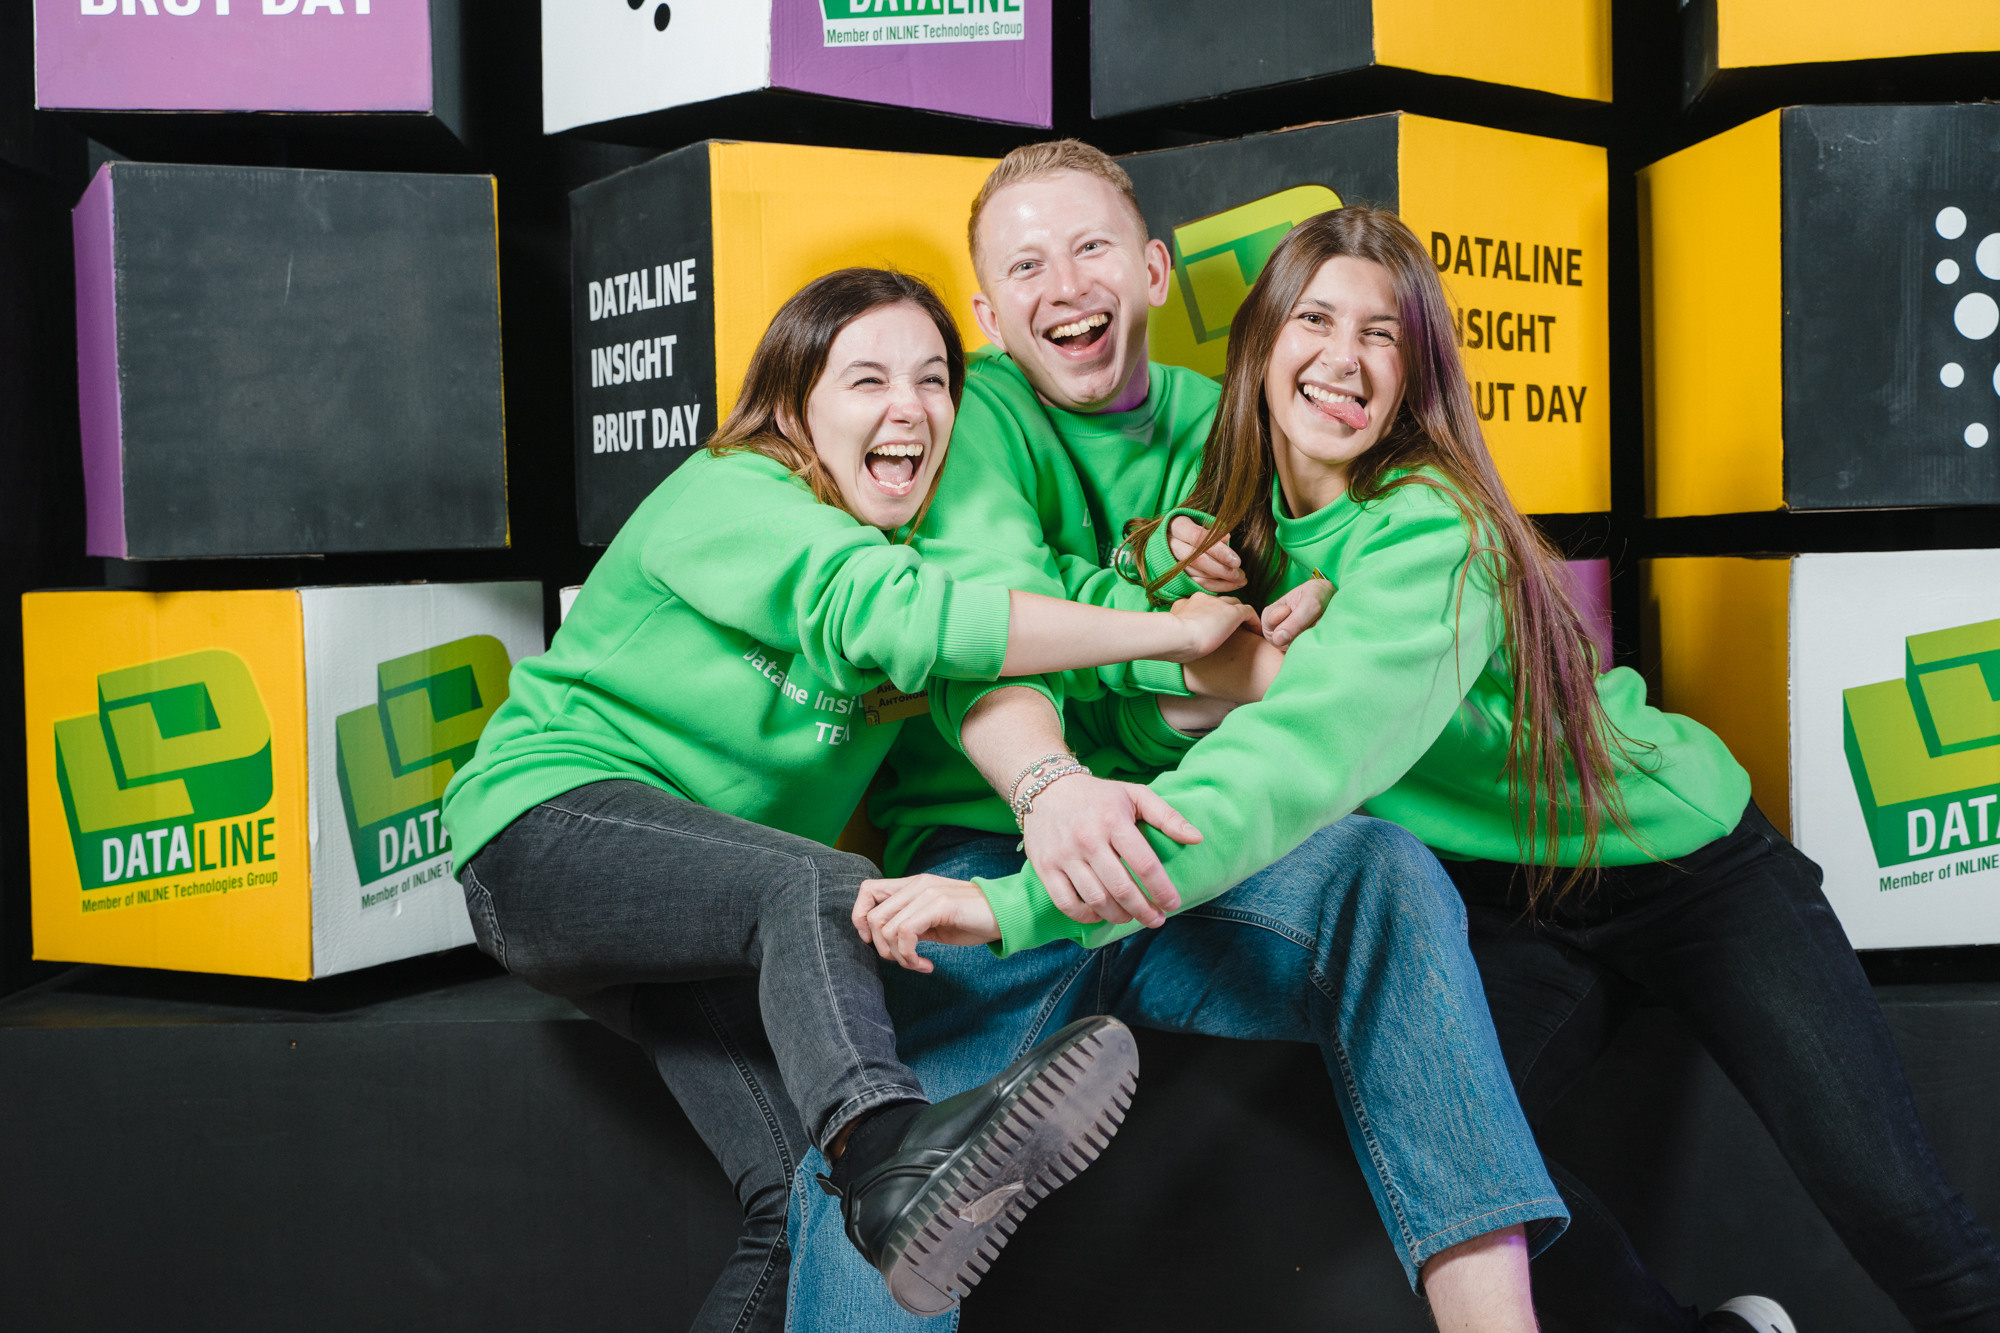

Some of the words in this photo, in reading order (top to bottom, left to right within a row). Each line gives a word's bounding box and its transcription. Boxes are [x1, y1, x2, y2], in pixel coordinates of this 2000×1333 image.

[827, 29, 869, 44] Member
[873, 26, 883, 41] of
[886, 25, 919, 40] INLINE
[923, 22, 989, 39] Technologies
[993, 21, 1022, 37] Group
[1431, 231, 1583, 287] DATALINE
[588, 258, 697, 322] DATALINE
[1450, 307, 1556, 353] NSIGHT
[591, 334, 677, 388] INSIGHT
[1526, 384, 1587, 423] DAY
[592, 410, 646, 454] BRUT
[652, 403, 700, 449] DAY
[1907, 794, 2000, 856] DAT
[82, 894, 121, 913] Member
[125, 890, 134, 906] of
[137, 886, 169, 904] INLINE
[174, 875, 243, 898] Technologies
[247, 871, 278, 887] Group
[362, 885, 398, 909] Member
[402, 877, 410, 893] of
[413, 863, 442, 888] INLINE
[1880, 871, 1934, 892] Member
[1938, 863, 1951, 880] of
[1955, 854, 2000, 876] INLINE
